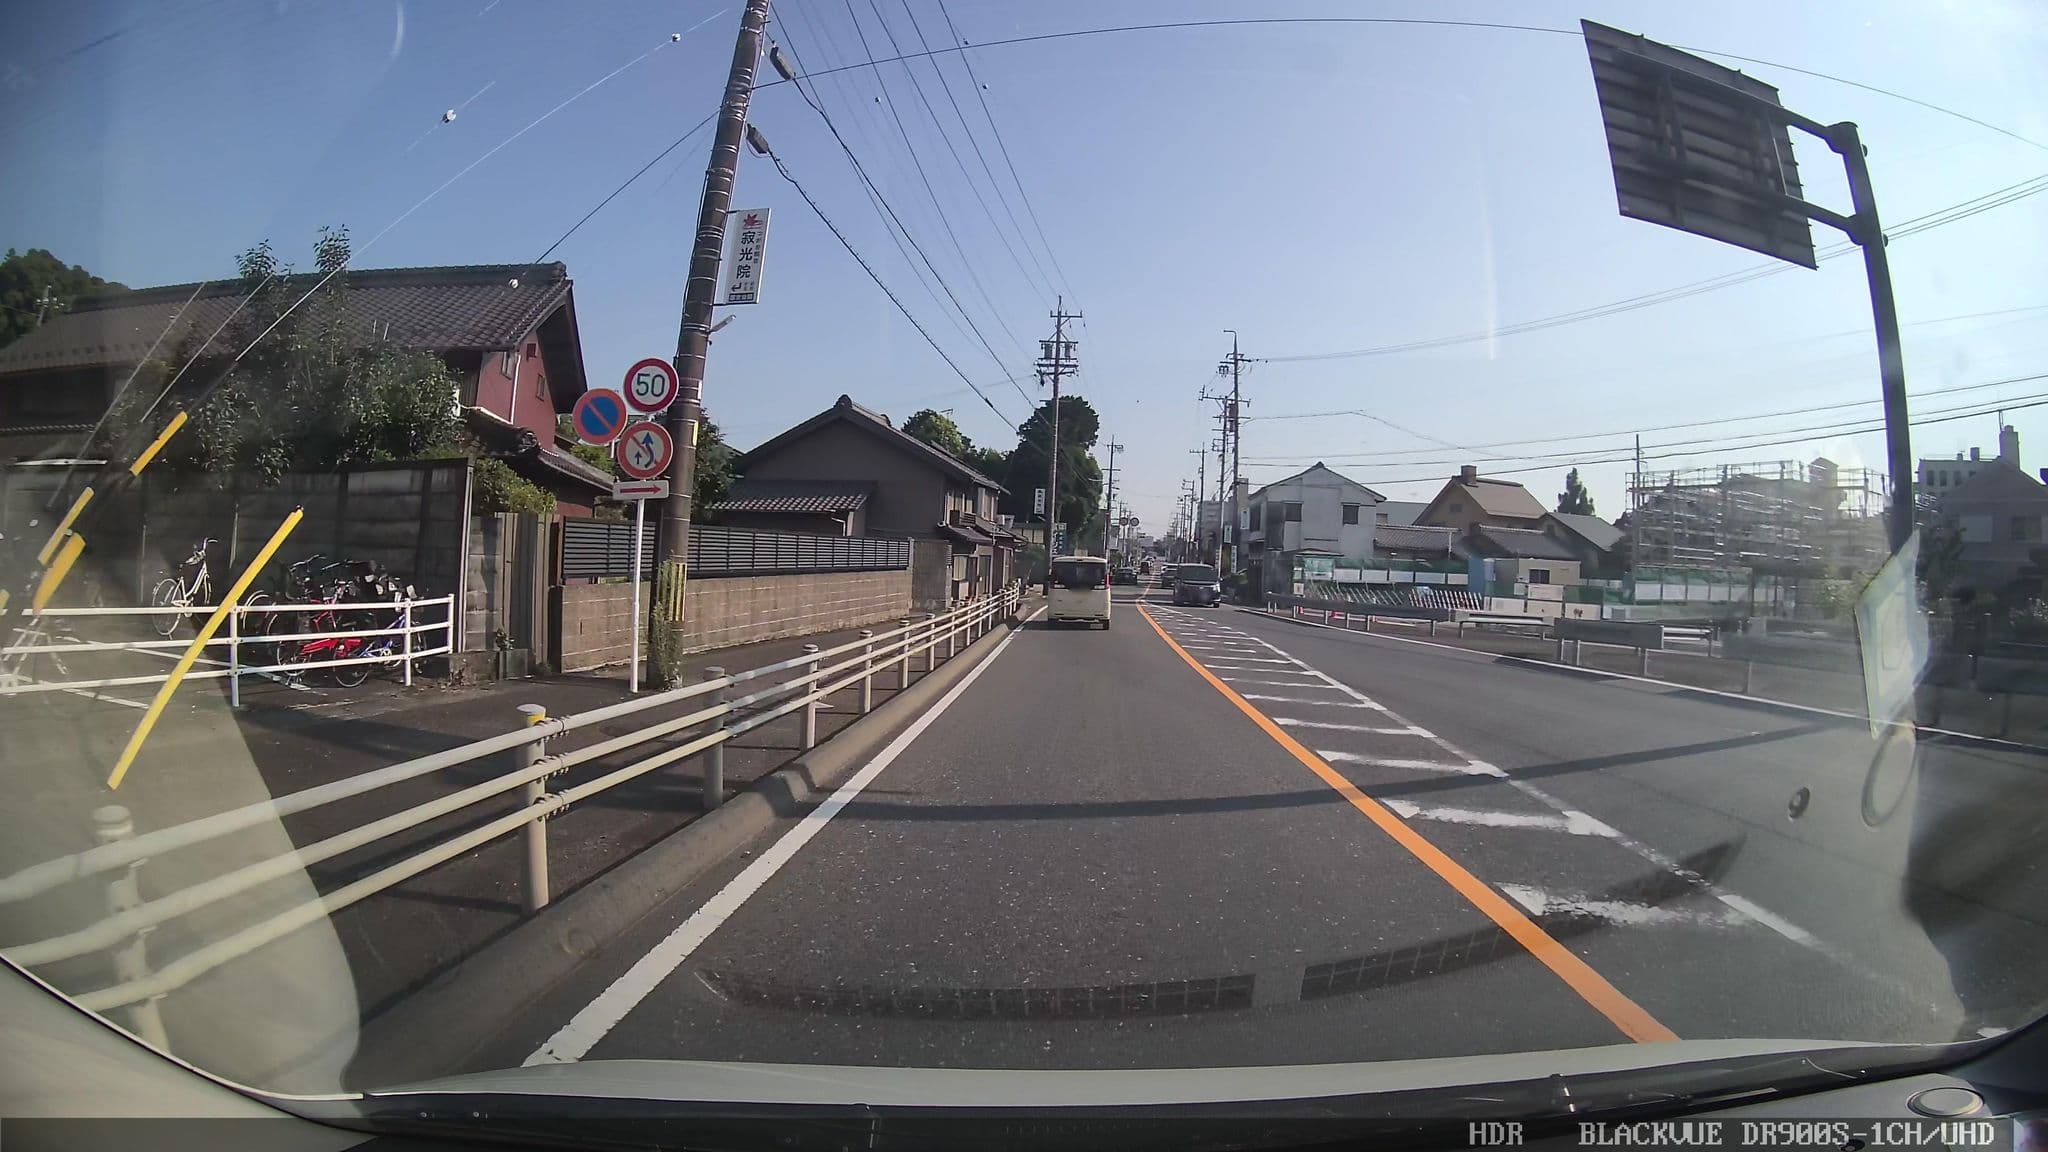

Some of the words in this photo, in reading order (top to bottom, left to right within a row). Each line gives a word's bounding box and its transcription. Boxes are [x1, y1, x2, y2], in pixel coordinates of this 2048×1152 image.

[736, 231, 756, 279] 寂光院
[636, 373, 665, 397] 50
